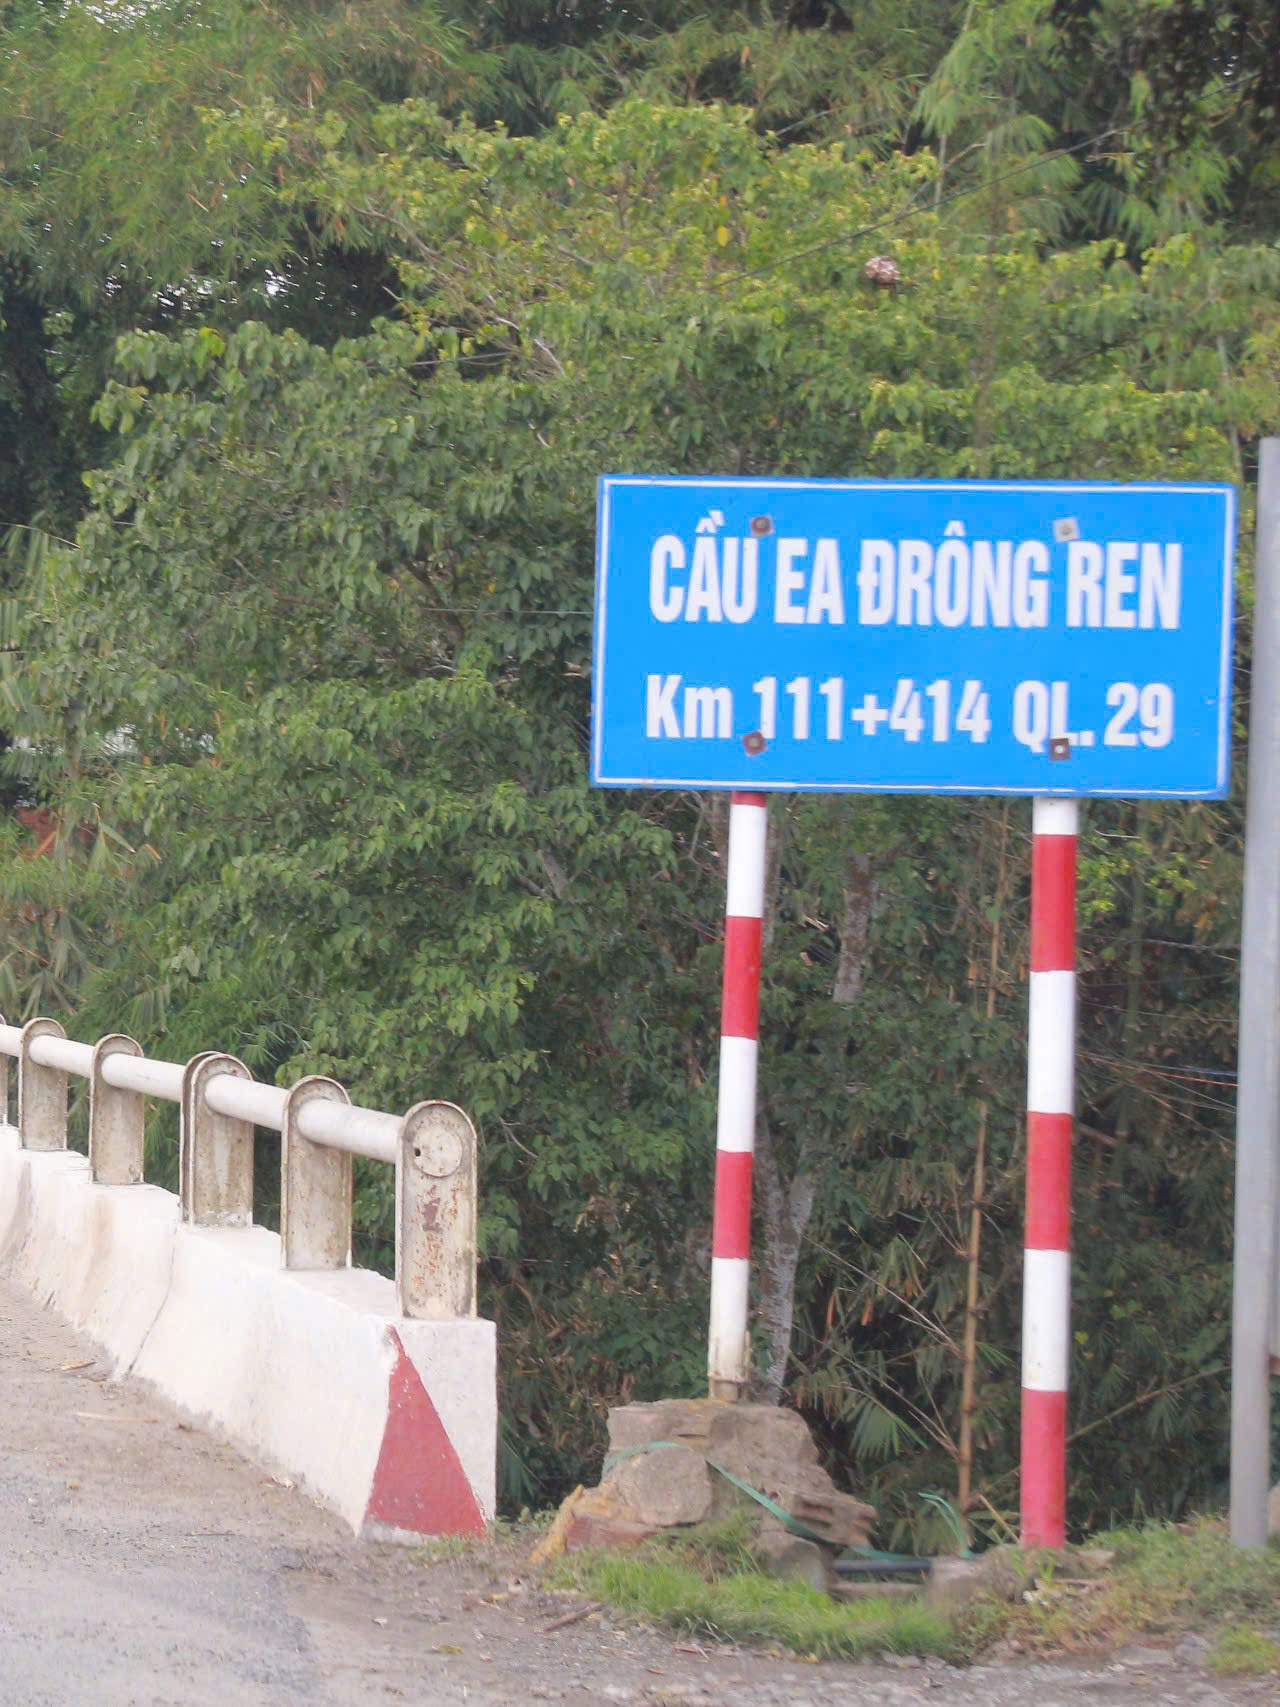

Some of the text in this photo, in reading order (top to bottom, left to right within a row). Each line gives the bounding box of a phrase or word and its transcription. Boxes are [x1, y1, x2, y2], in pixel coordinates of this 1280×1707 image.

[649, 510, 1182, 630] CẦU EA ĐRÔNG REN
[646, 674, 733, 739] Km
[752, 676, 991, 743] 111+414
